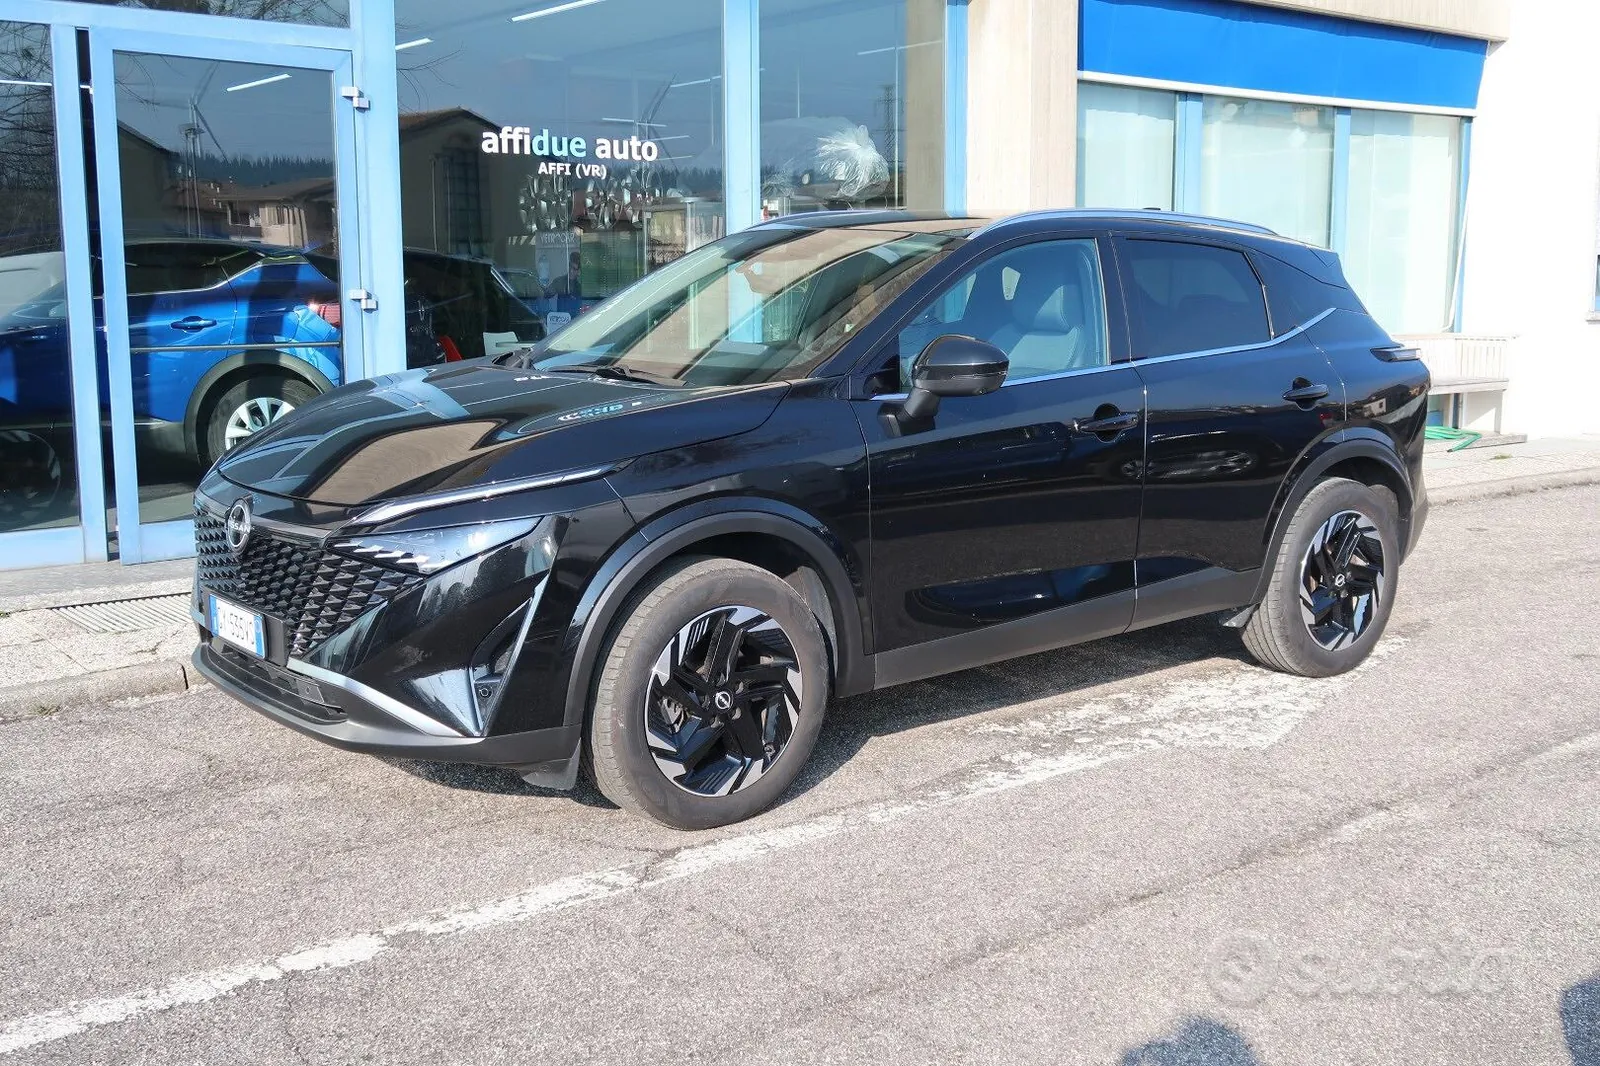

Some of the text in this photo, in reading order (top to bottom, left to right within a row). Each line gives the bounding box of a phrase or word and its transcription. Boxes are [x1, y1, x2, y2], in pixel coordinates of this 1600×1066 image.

[482, 125, 658, 161] affidue auto
[538, 161, 607, 180] AFFI (VR)
[228, 519, 250, 533] SSAN
